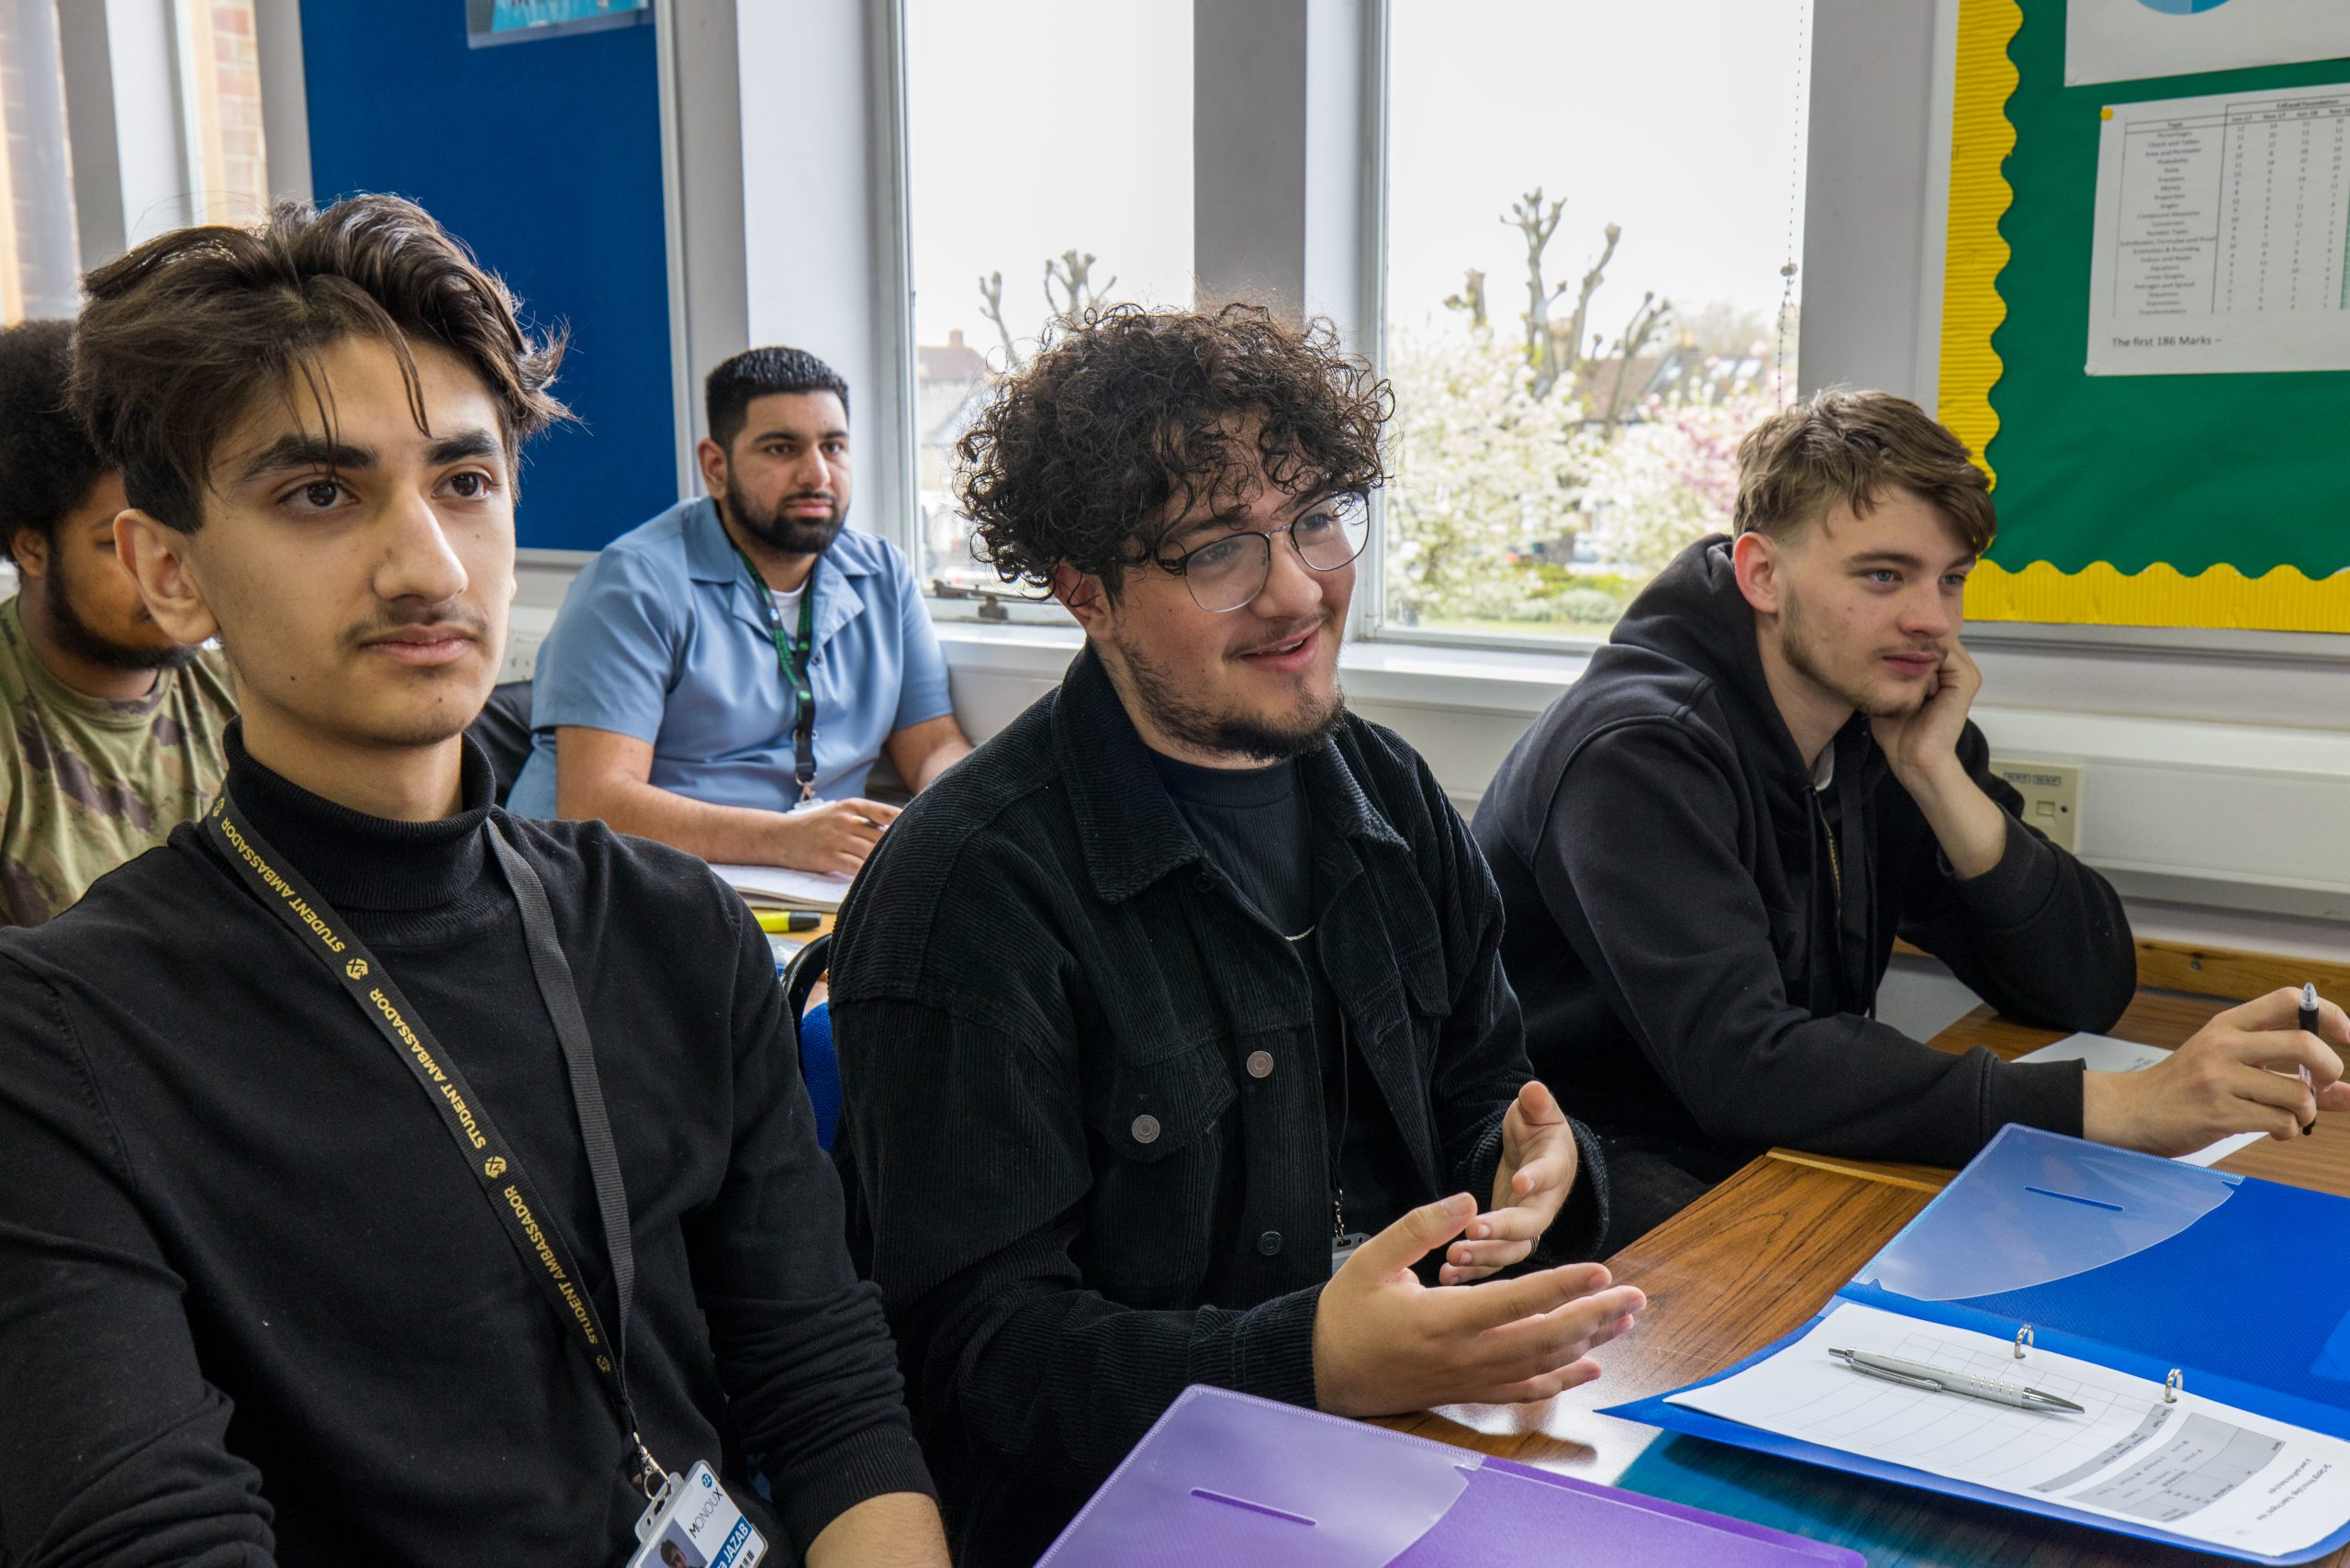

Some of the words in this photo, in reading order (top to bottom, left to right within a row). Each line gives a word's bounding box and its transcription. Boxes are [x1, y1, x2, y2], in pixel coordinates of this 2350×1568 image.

[2112, 338, 2131, 347] The
[2132, 337, 2154, 346] first
[2157, 336, 2177, 346] 186
[2179, 335, 2211, 346] Marks
[221, 816, 295, 898] AMBASSADOR
[288, 897, 346, 953] STUDENT
[369, 987, 448, 1082] AMBASSADOR
[440, 1083, 487, 1149] STUDENT
[503, 1184, 565, 1279] AMBASSADOR
[558, 1281, 598, 1345] STUDENT
[701, 1473, 711, 1486] 22
[688, 1486, 723, 1539] MONOUX
[723, 1522, 749, 1562] JAZAB
